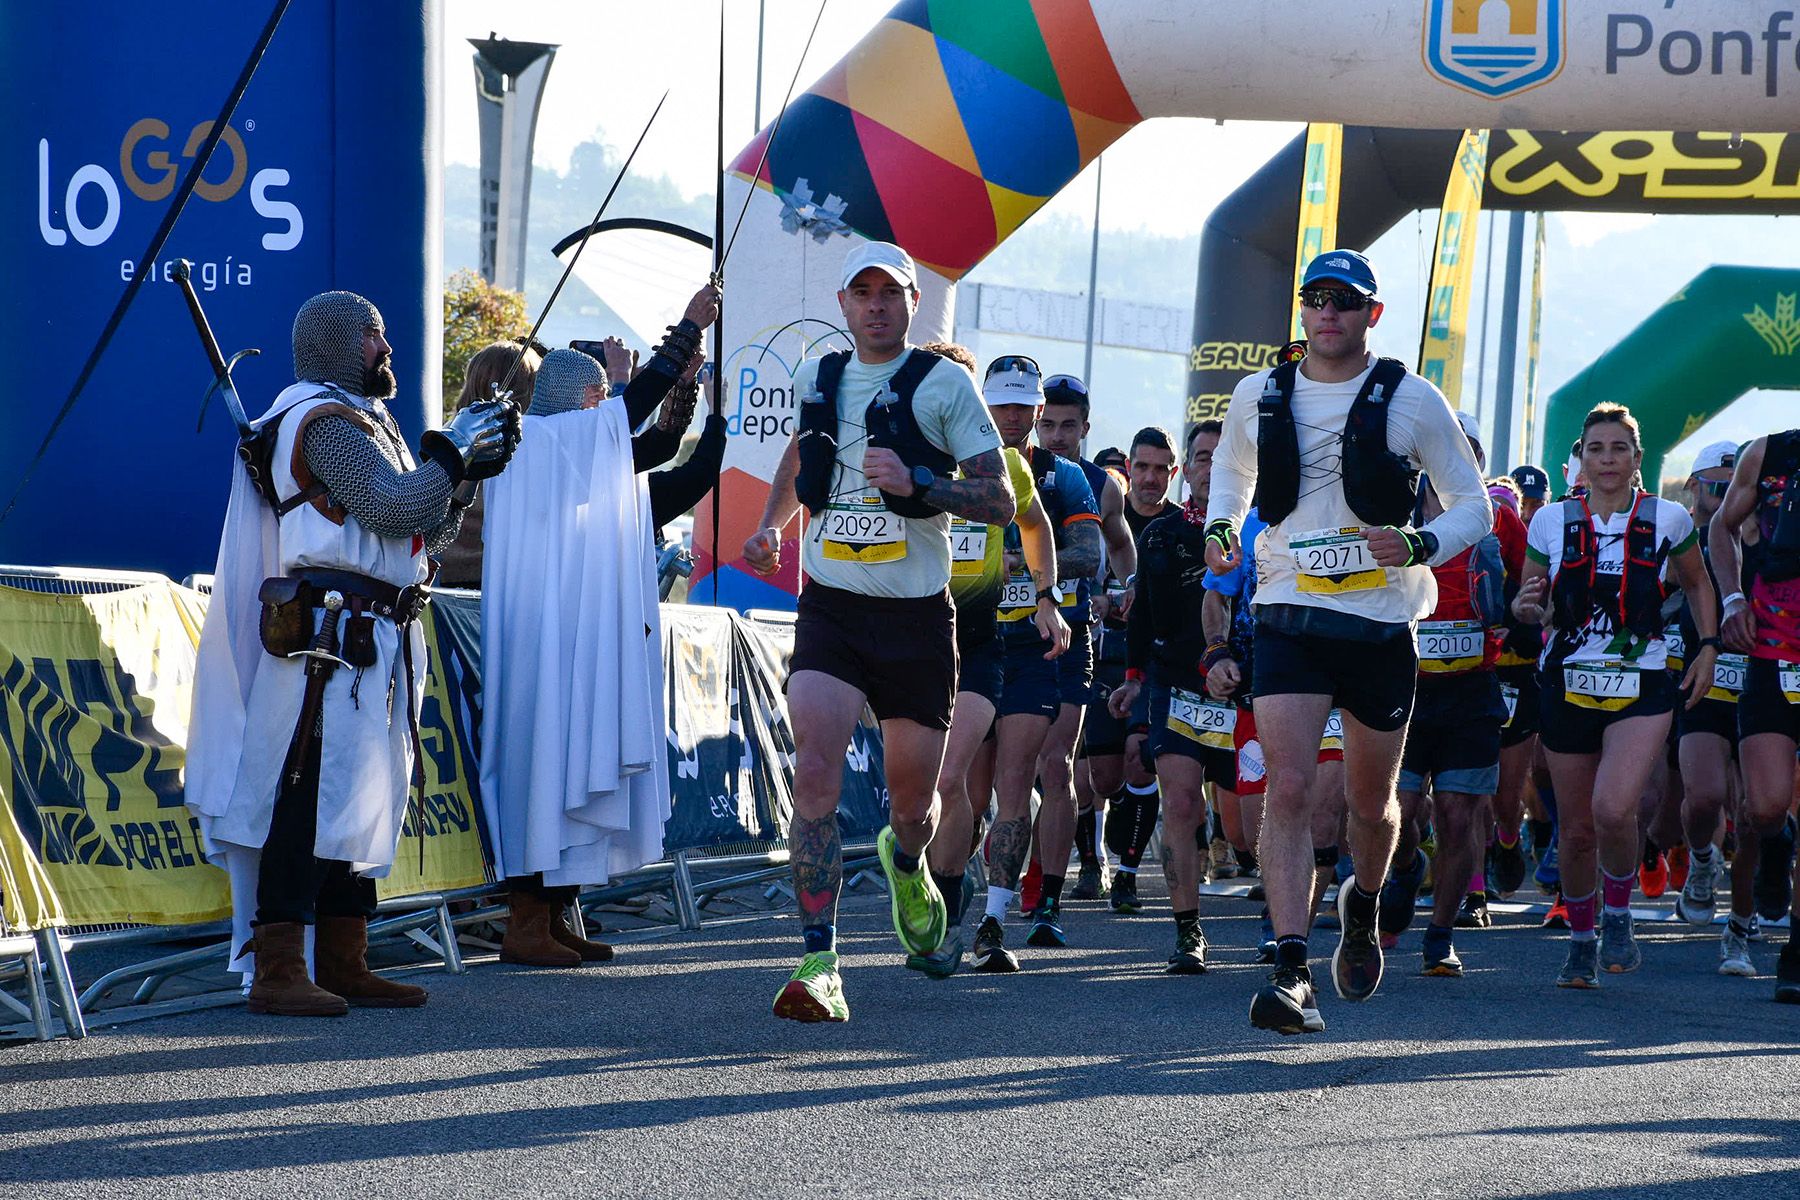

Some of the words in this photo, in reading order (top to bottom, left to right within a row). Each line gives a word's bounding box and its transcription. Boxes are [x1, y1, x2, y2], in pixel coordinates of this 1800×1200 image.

[1606, 11, 1800, 97] Ponf
[120, 256, 252, 291] enegía
[833, 515, 887, 537] 2092
[1309, 545, 1363, 571] 2071
[1427, 636, 1472, 654] 2010
[1577, 673, 1625, 692] 2177
[1182, 705, 1225, 727] 2128
[111, 822, 167, 870] POR
[159, 819, 196, 868] EL
